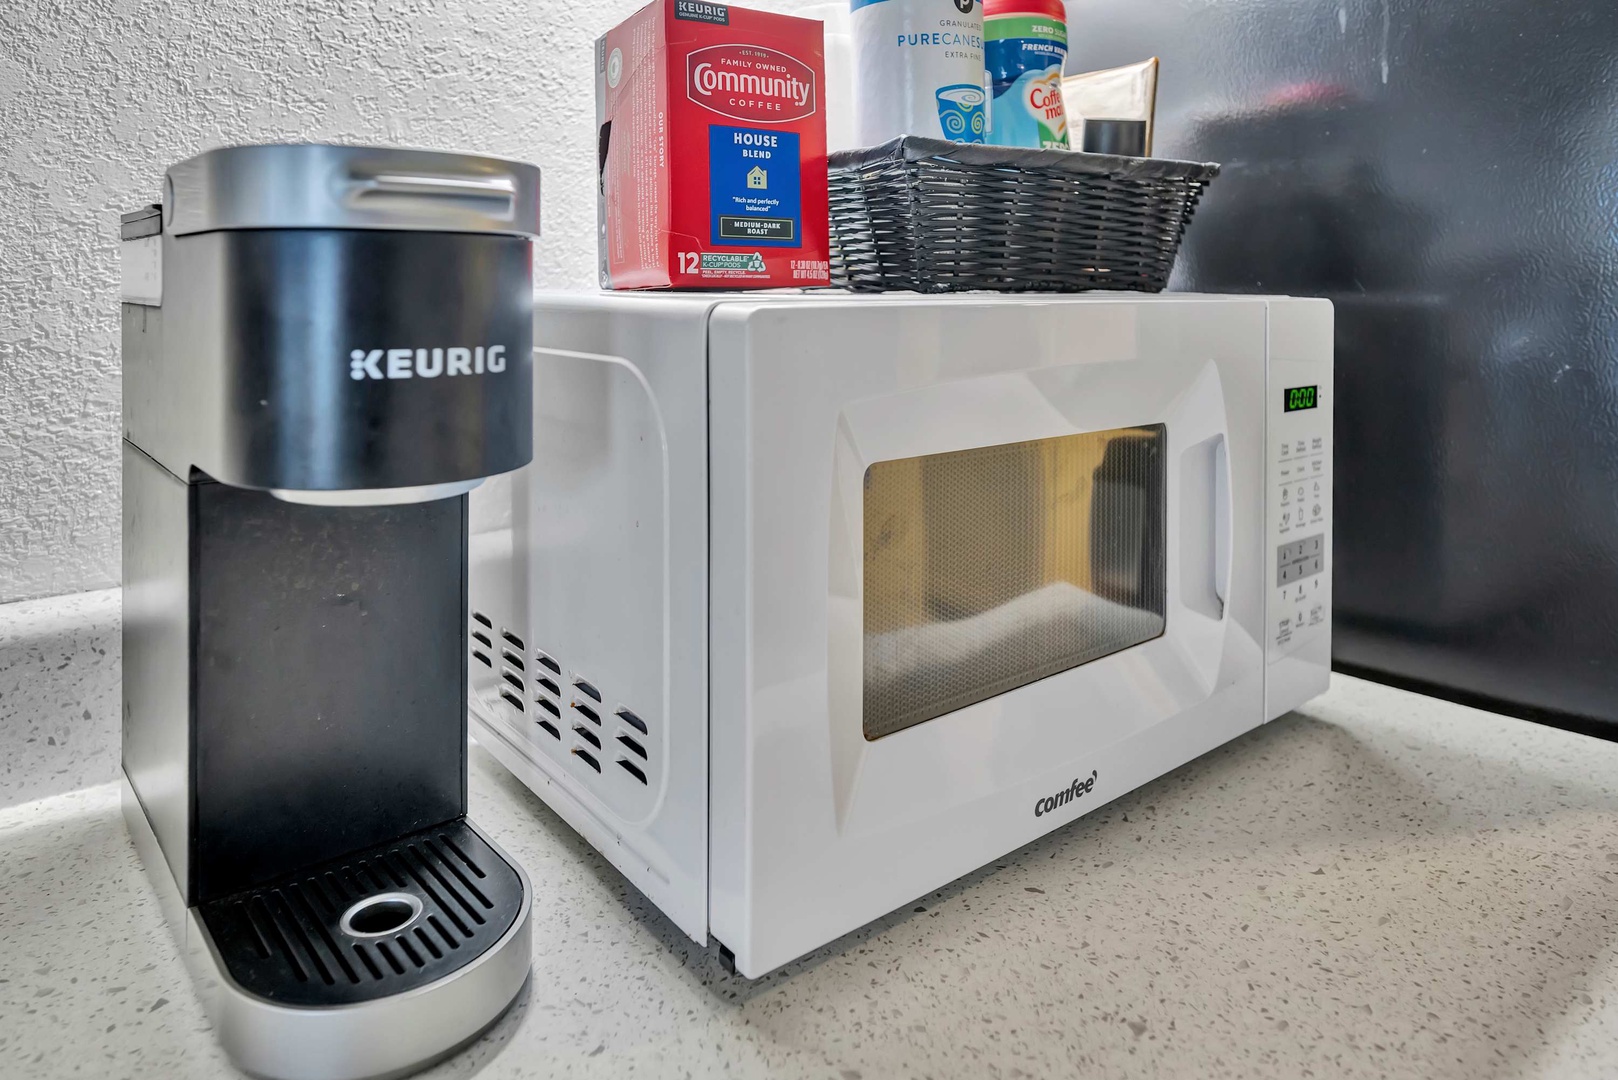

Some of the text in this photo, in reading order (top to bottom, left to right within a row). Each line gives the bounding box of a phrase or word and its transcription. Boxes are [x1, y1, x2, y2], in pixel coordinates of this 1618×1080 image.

[1032, 25, 1053, 34] ZERO
[1022, 44, 1053, 52] FRENCH
[721, 58, 787, 72] FAMILY OWNED
[694, 63, 810, 106] Community
[729, 98, 781, 110] COFFEE
[734, 132, 778, 148] HOUSE
[742, 149, 771, 159] BLEND
[758, 198, 779, 206] perfectly
[678, 252, 699, 274] 12
[350, 344, 506, 380] KEURIG
